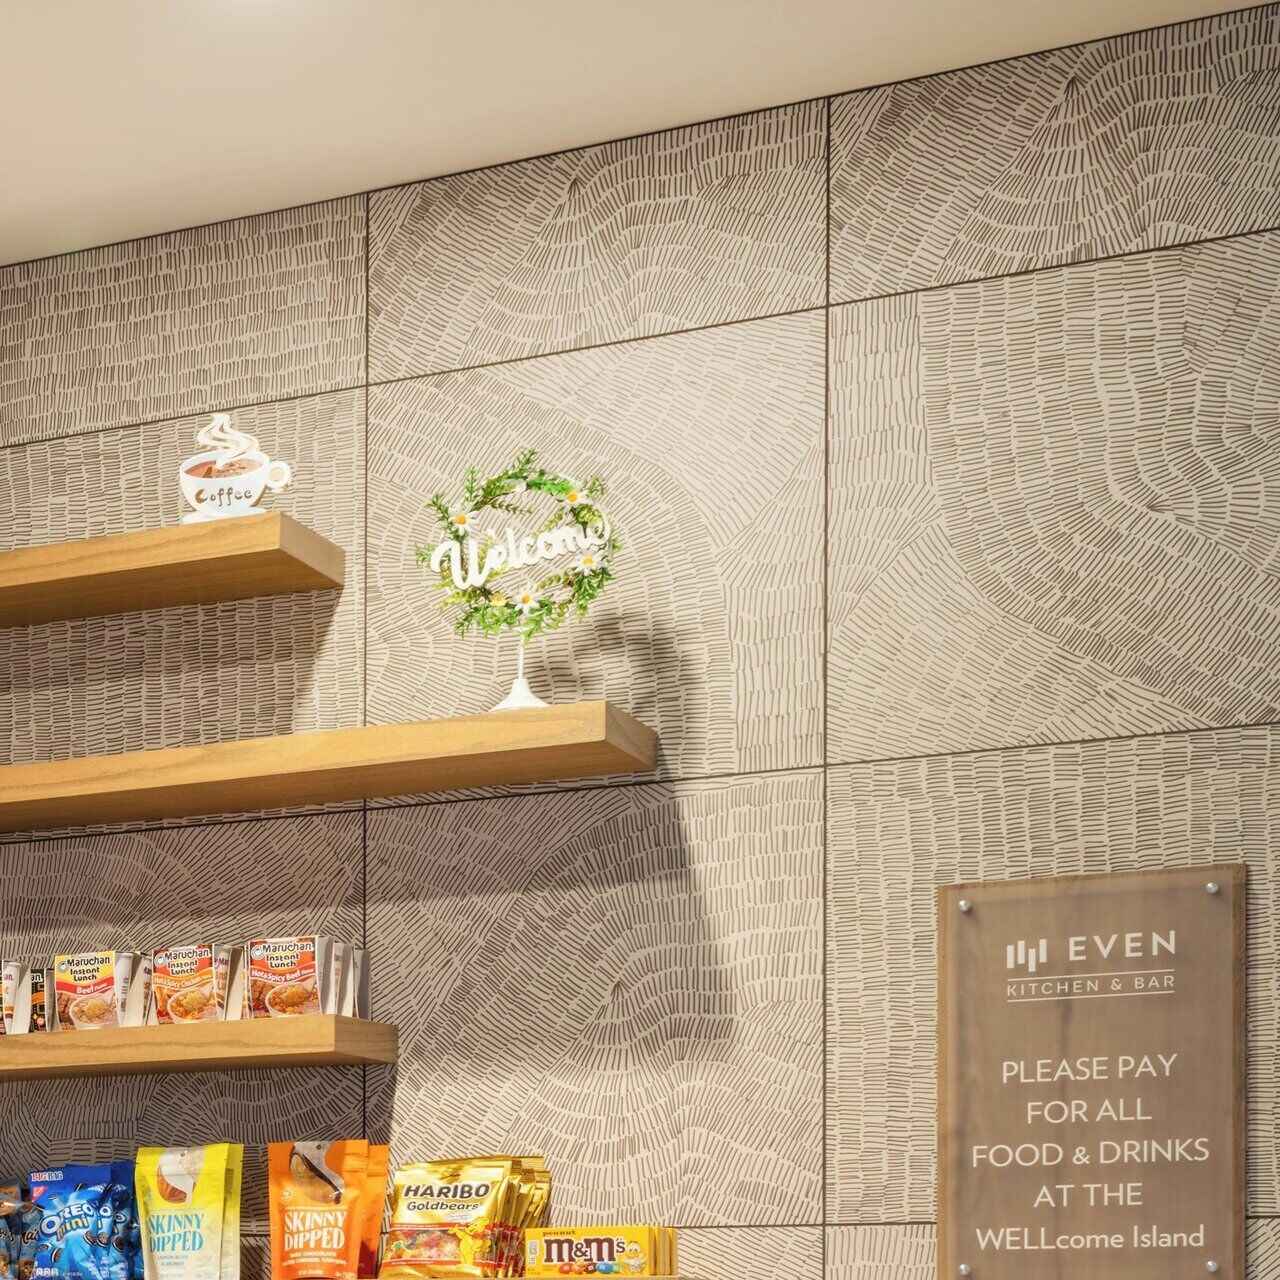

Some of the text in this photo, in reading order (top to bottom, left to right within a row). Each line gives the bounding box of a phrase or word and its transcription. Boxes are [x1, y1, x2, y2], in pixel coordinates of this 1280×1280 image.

[195, 487, 252, 507] Coffee
[263, 942, 312, 953] Maruchan
[1069, 930, 1175, 961] EVEN
[67, 956, 110, 967] Maruchan
[164, 949, 210, 961] Maruchan
[168, 959, 198, 968] Instant
[266, 953, 299, 961] Instant
[270, 960, 296, 968] Lunch
[70, 967, 100, 975] Instant
[73, 974, 97, 982] Lunch
[171, 967, 195, 975] Lunch
[77, 985, 94, 994] Beef
[1007, 975, 1175, 996] KITCHEN & BAR
[1002, 1053, 1177, 1083] PLEASE PAY
[1027, 1098, 1151, 1124] FOR ALL
[972, 1137, 1209, 1167] FOOD & DRINKS
[404, 1182, 492, 1200] HARIBO
[1034, 1183, 1143, 1207] AT THE
[407, 1200, 480, 1213] Goldbears
[40, 1200, 95, 1235] OREO
[149, 1213, 203, 1232] SKINNY
[285, 1211, 347, 1229] SKINNY
[149, 1233, 204, 1253] DIPPED
[285, 1229, 346, 1251] DIPPED
[543, 1230, 577, 1238] peanut
[976, 1224, 1204, 1250] WELLcome Island
